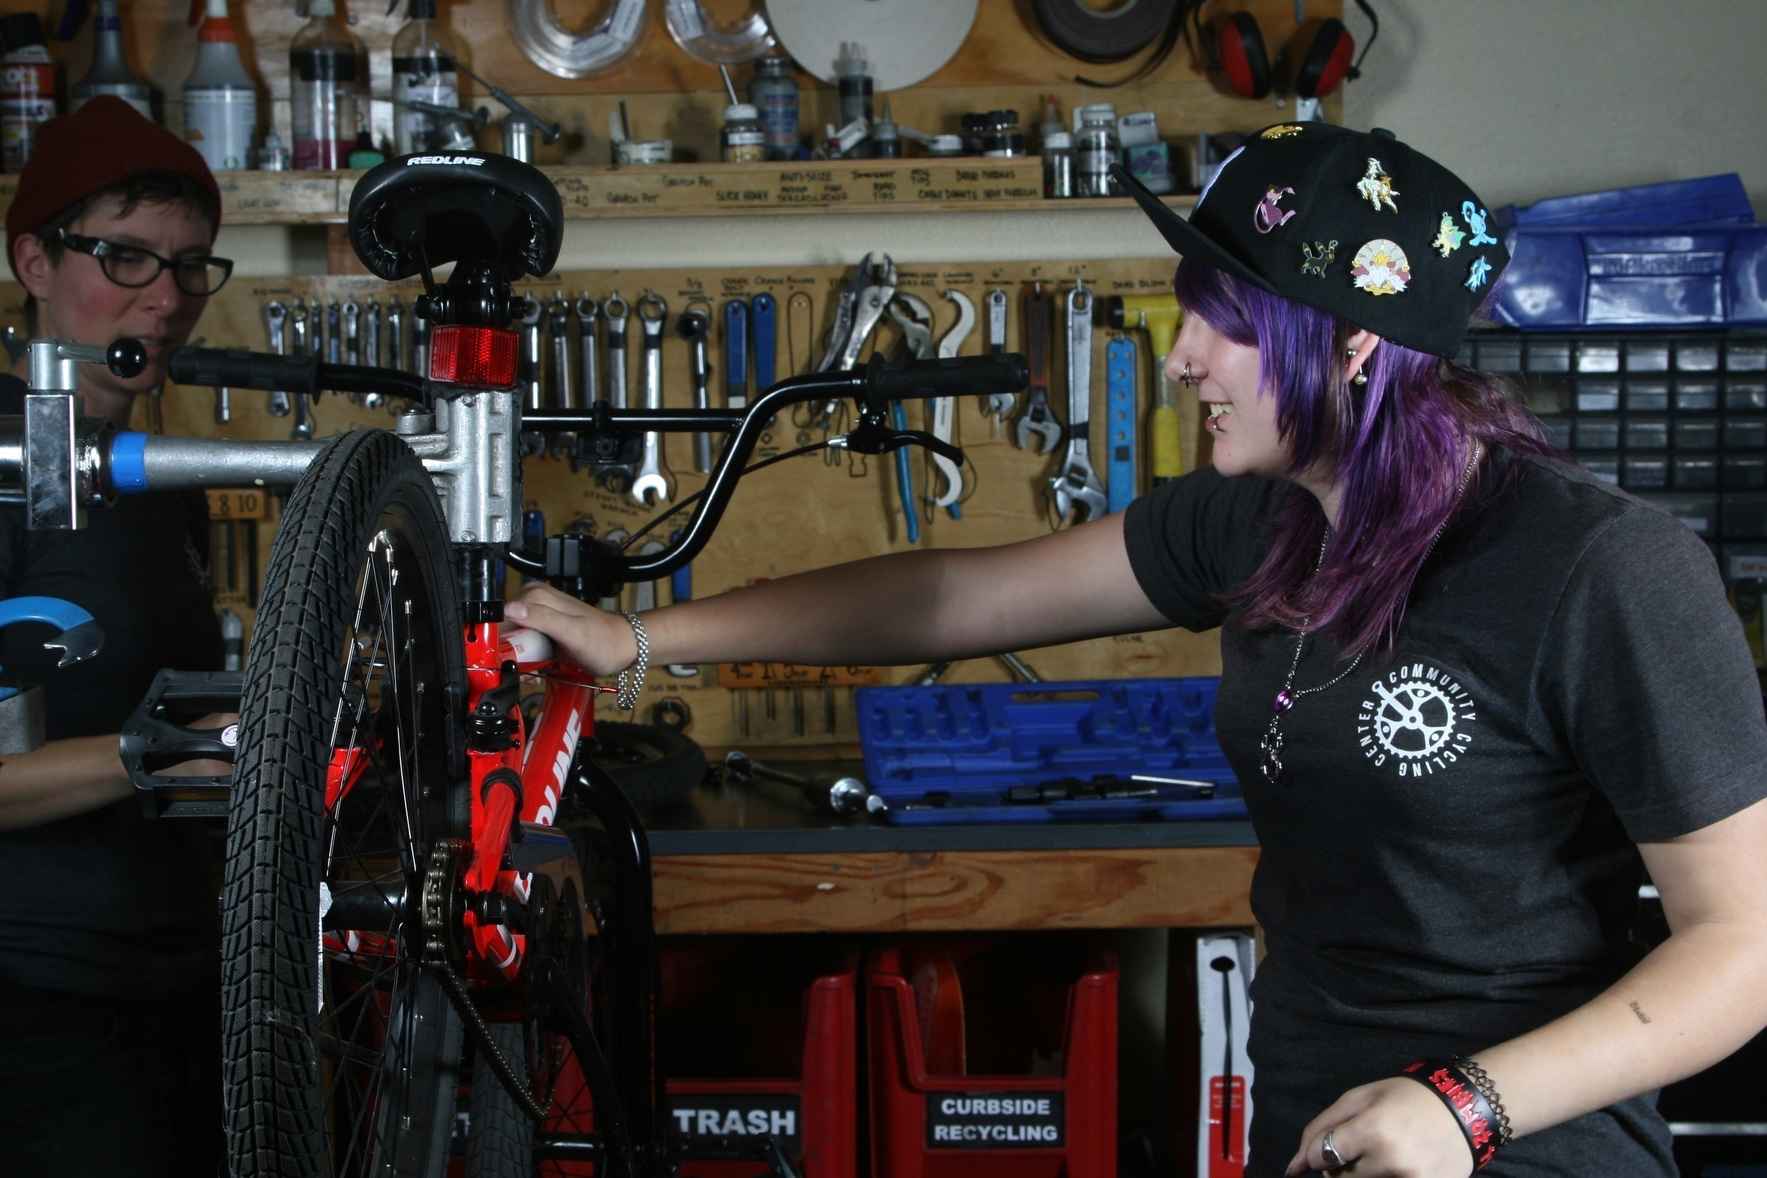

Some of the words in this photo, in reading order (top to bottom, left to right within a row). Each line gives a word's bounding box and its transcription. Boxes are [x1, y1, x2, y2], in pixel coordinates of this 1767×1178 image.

[407, 155, 486, 167] REDLINE
[238, 493, 257, 512] 10
[1389, 664, 1476, 720] COMMUNITY
[1358, 700, 1386, 767] CENTER
[1398, 733, 1472, 777] CYCLING
[940, 1097, 1051, 1116] CURBSIDE
[672, 1108, 796, 1137] TRASH
[932, 1123, 1060, 1144] RECYCLING
